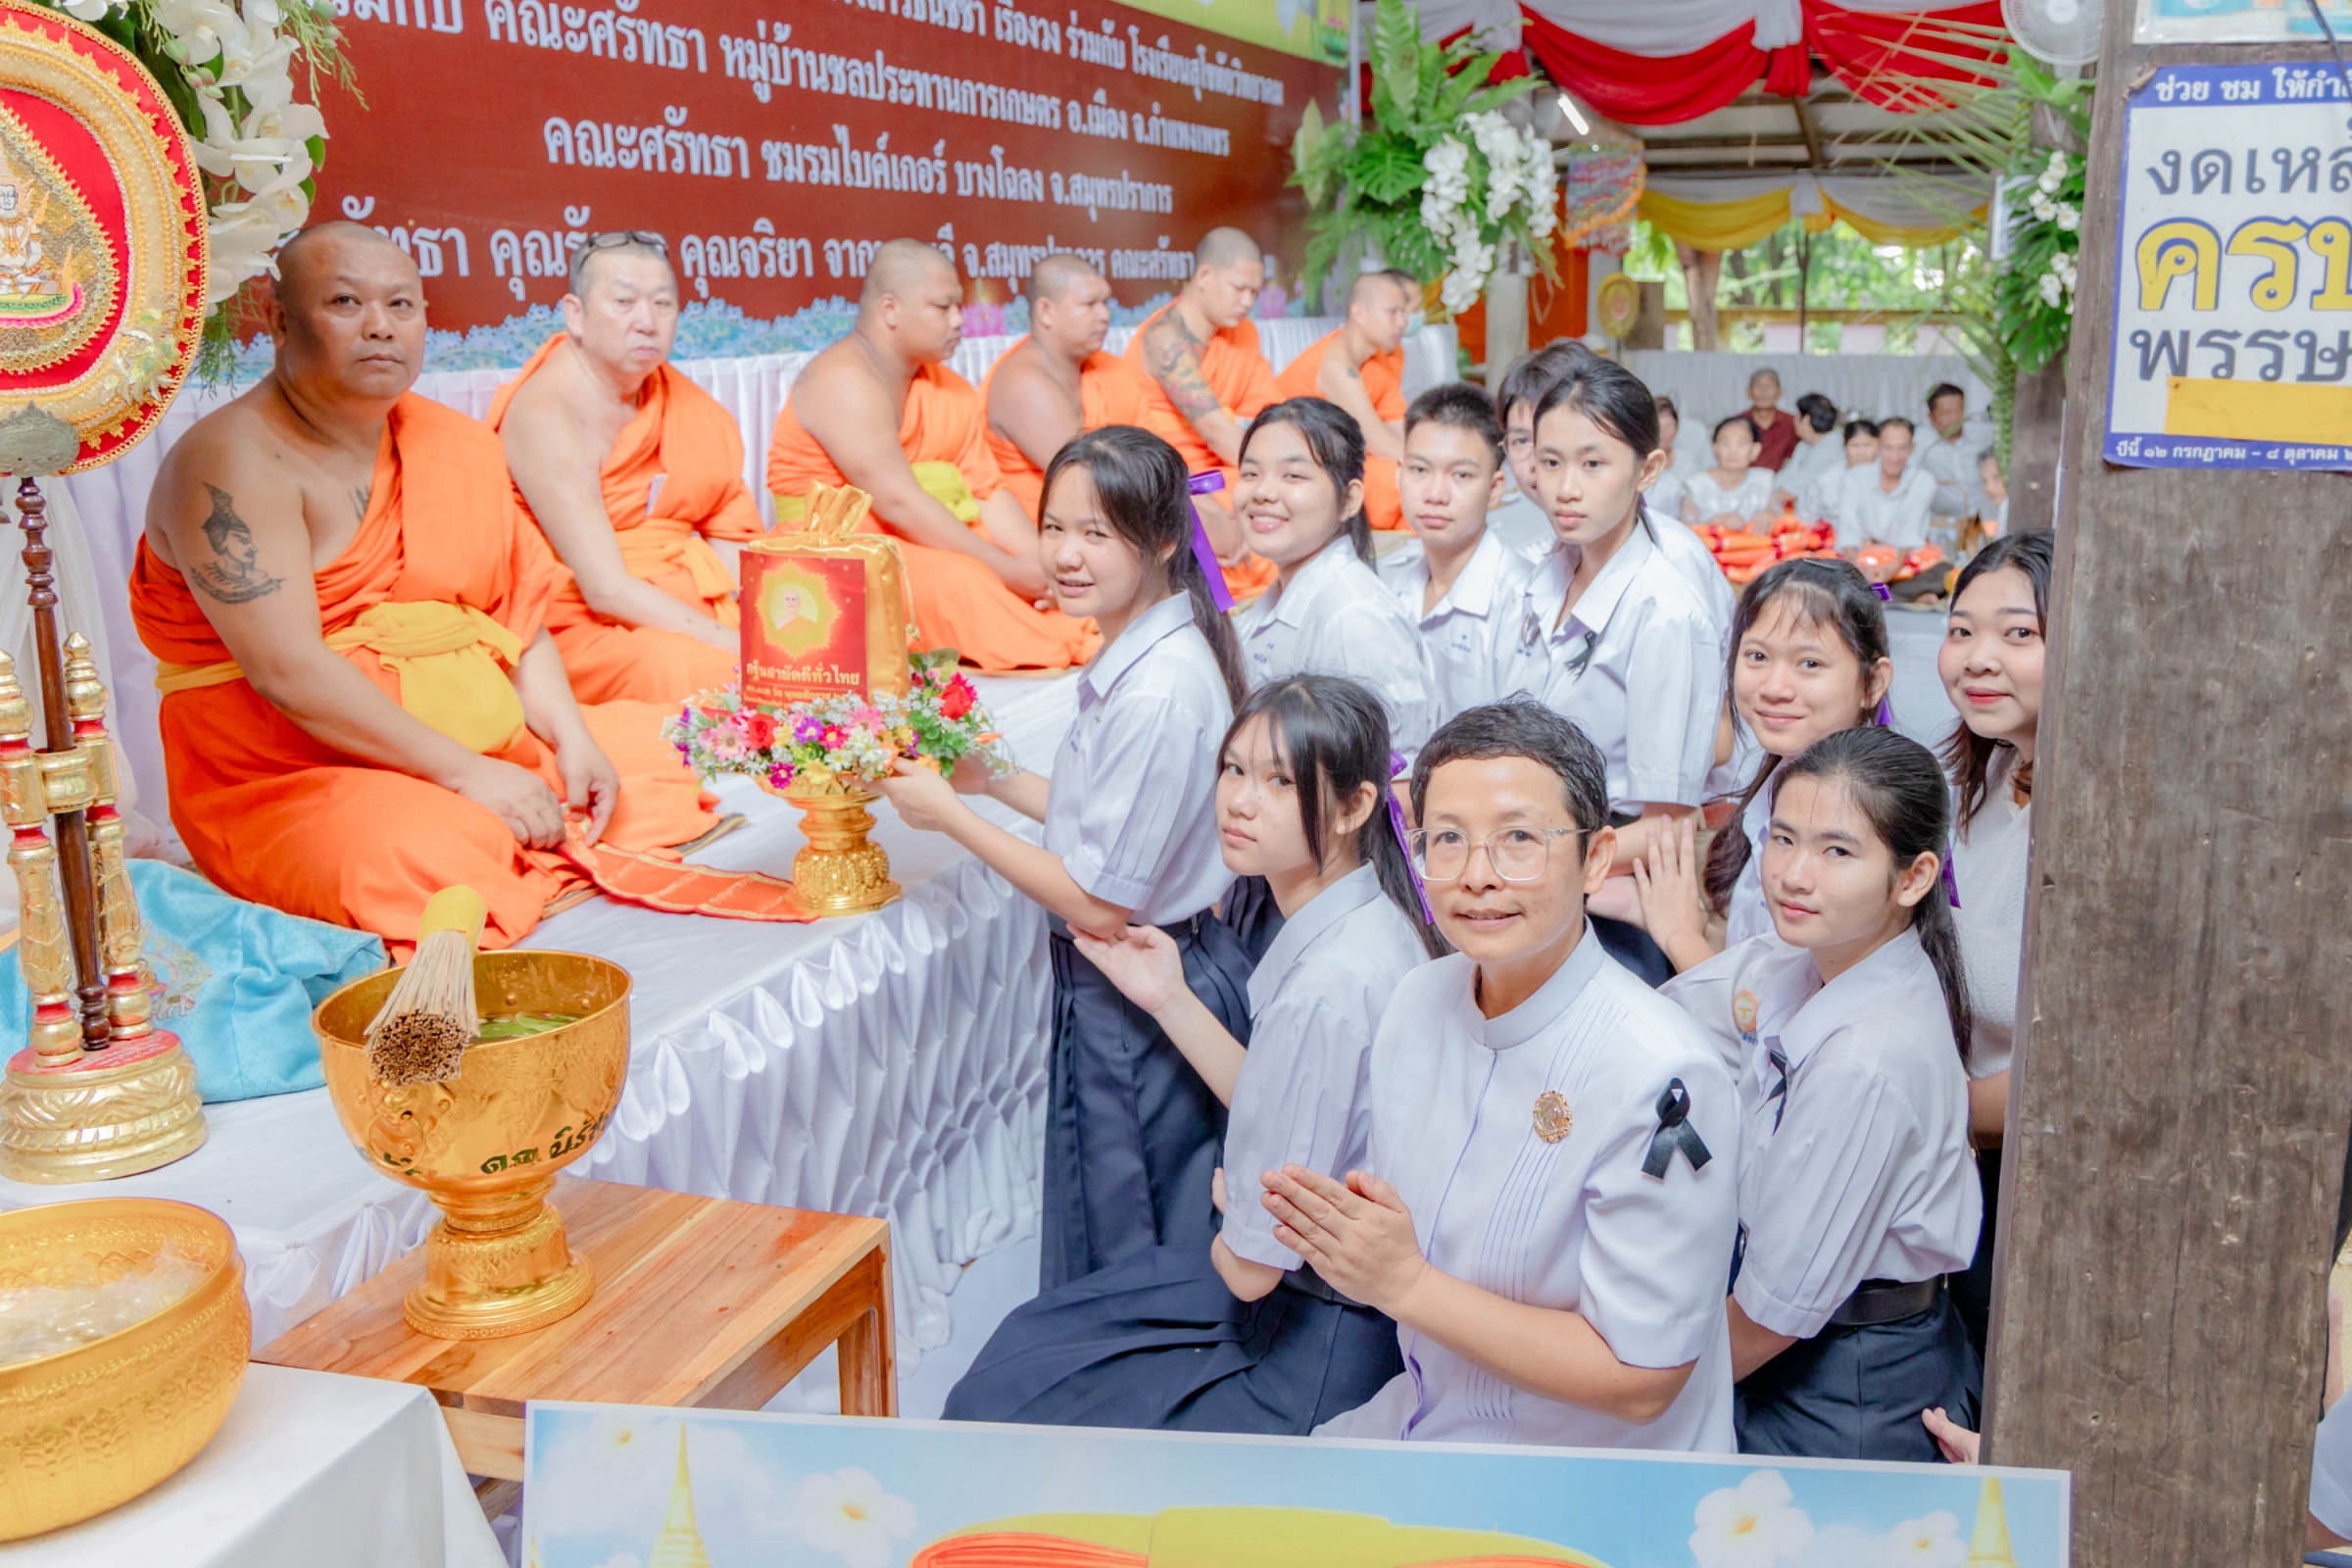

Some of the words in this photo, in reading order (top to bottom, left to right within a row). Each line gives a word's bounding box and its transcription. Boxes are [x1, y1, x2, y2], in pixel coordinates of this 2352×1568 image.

[1065, 9, 1126, 71] ร่วมกับ
[718, 19, 1061, 130] หมู่บ้านชลประทานการเกษตร
[1066, 87, 1128, 141] อ.เมือง
[2154, 74, 2210, 102] ช่วย
[2220, 79, 2261, 101] ชม
[543, 105, 751, 179] คณะศรัทธา
[760, 123, 949, 195] ชมรมไบค์เกอร์
[1050, 169, 1174, 223] จ.สมุทรปราการ
[680, 217, 814, 299] คุณจริยา
[2172, 444, 2247, 464] กรกฎาคม
[2283, 447, 2339, 466] ตุลาคม
